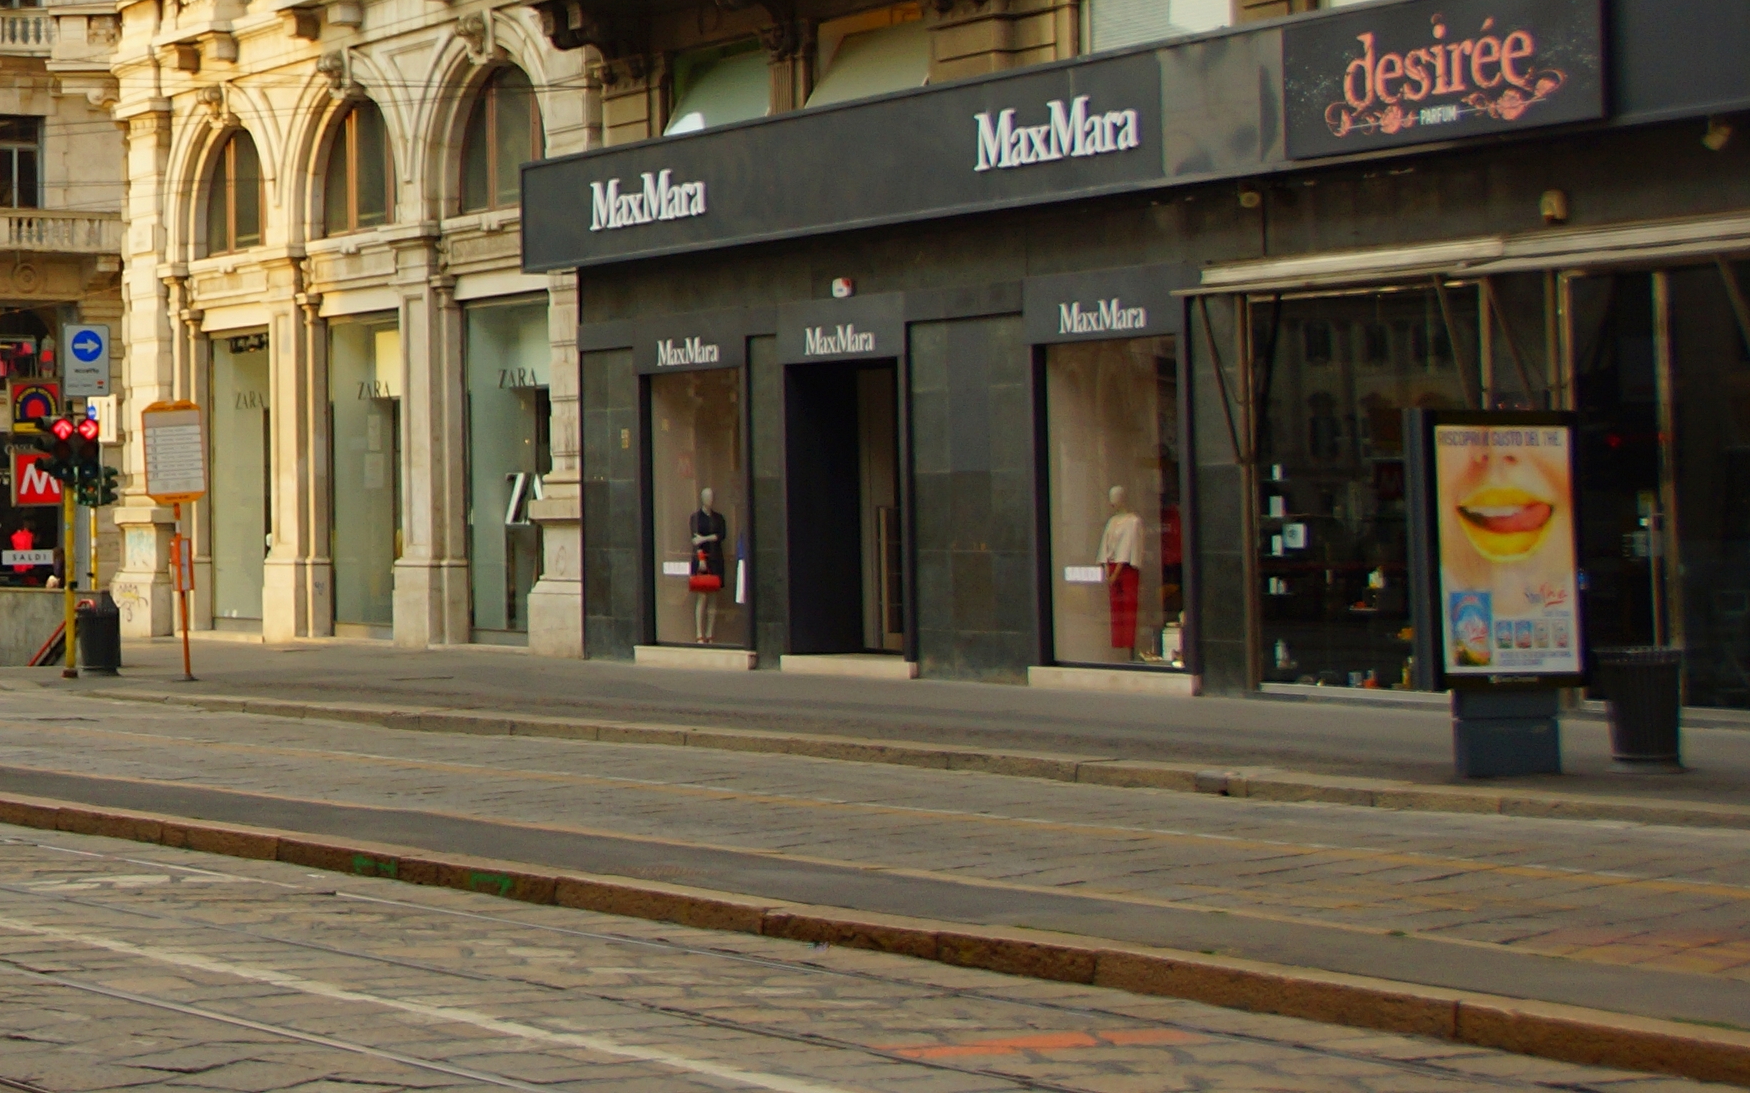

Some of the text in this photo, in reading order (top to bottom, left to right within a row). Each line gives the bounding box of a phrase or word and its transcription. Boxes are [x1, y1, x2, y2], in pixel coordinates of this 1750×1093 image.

[1343, 15, 1535, 108] desirée
[1419, 105, 1457, 125] PARFUM
[974, 94, 1139, 172] MaxMara
[590, 169, 707, 232] MaxMara
[1057, 297, 1147, 334] MaxMara
[656, 336, 720, 367] MaxMara
[804, 322, 876, 356] MaxMara
[357, 379, 392, 401] ZARA
[497, 367, 538, 390] ZARA
[234, 390, 264, 410] ZARA
[12, 552, 48, 562] SALDI
